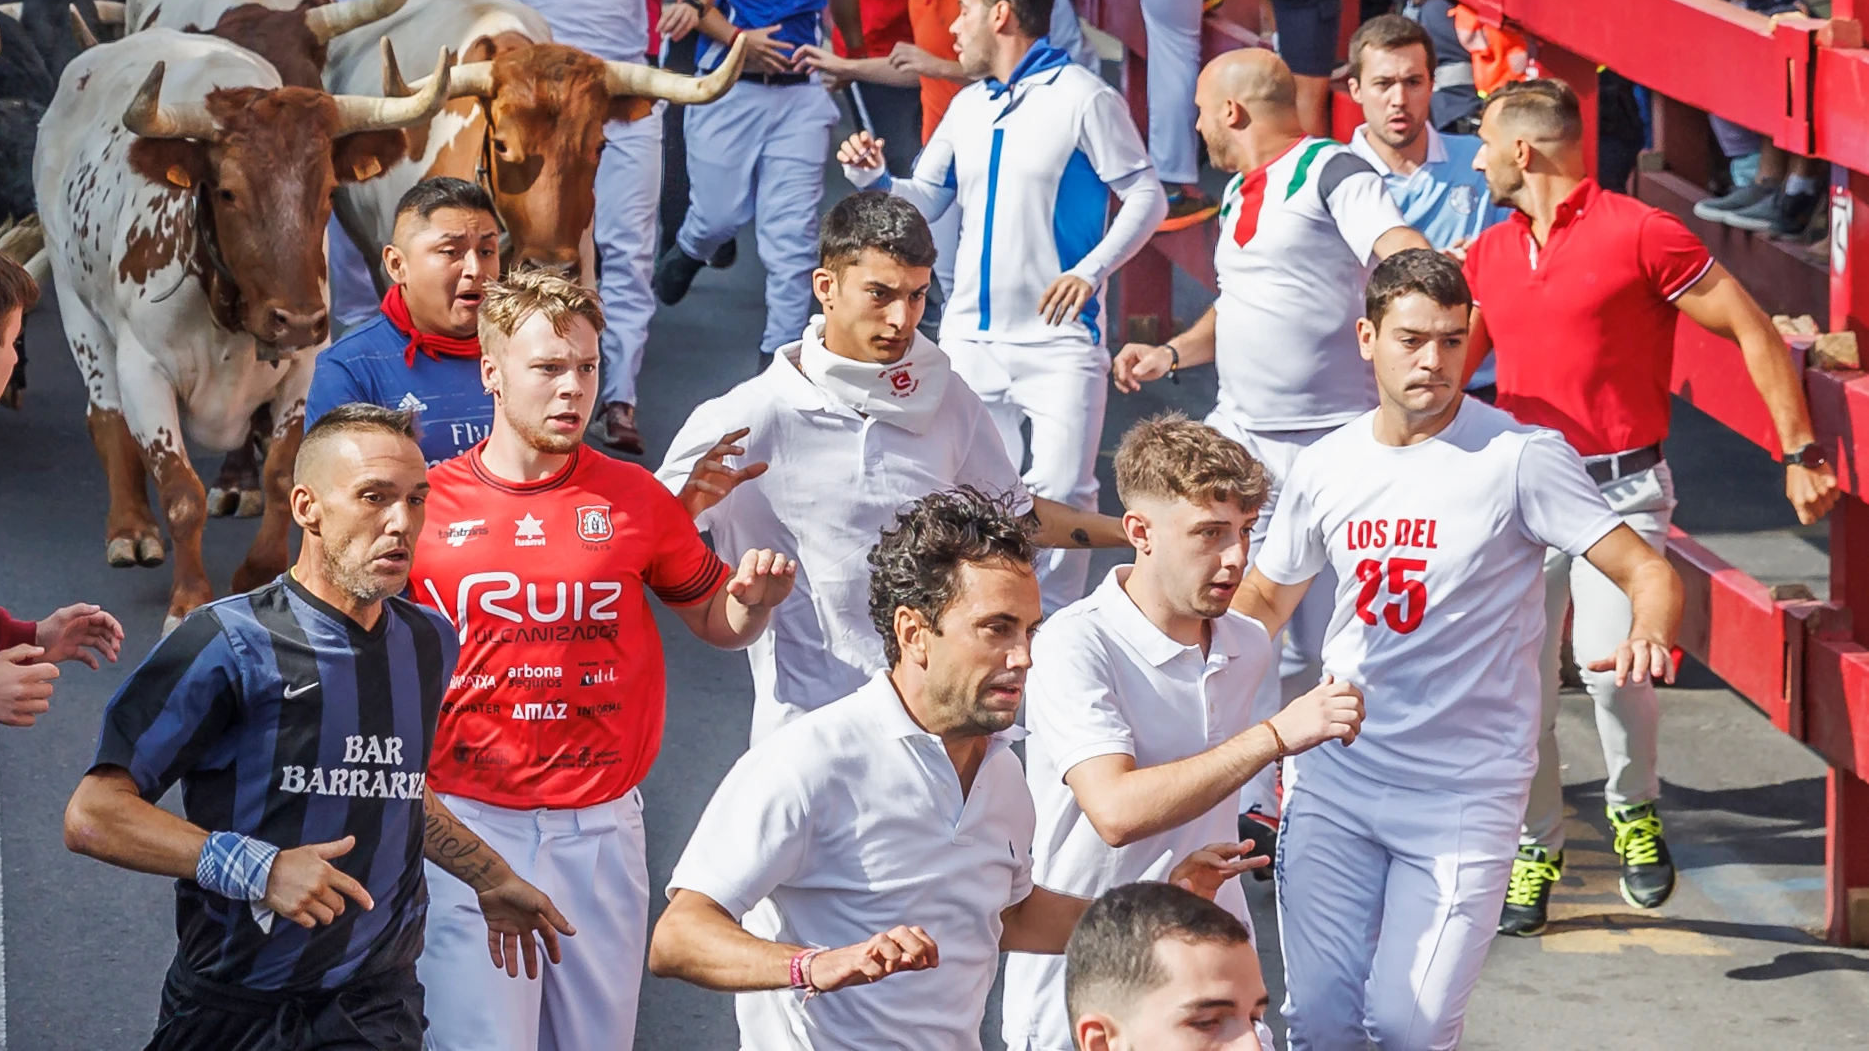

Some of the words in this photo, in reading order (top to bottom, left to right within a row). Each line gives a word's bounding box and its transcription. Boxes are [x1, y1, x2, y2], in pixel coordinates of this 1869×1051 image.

[1347, 518, 1388, 550] LOS
[1394, 518, 1438, 549] DEL
[1355, 557, 1428, 635] 25
[507, 663, 563, 678] arbona
[508, 679, 562, 691] seguros
[512, 703, 568, 720] AMAZ
[343, 735, 404, 765] BAR
